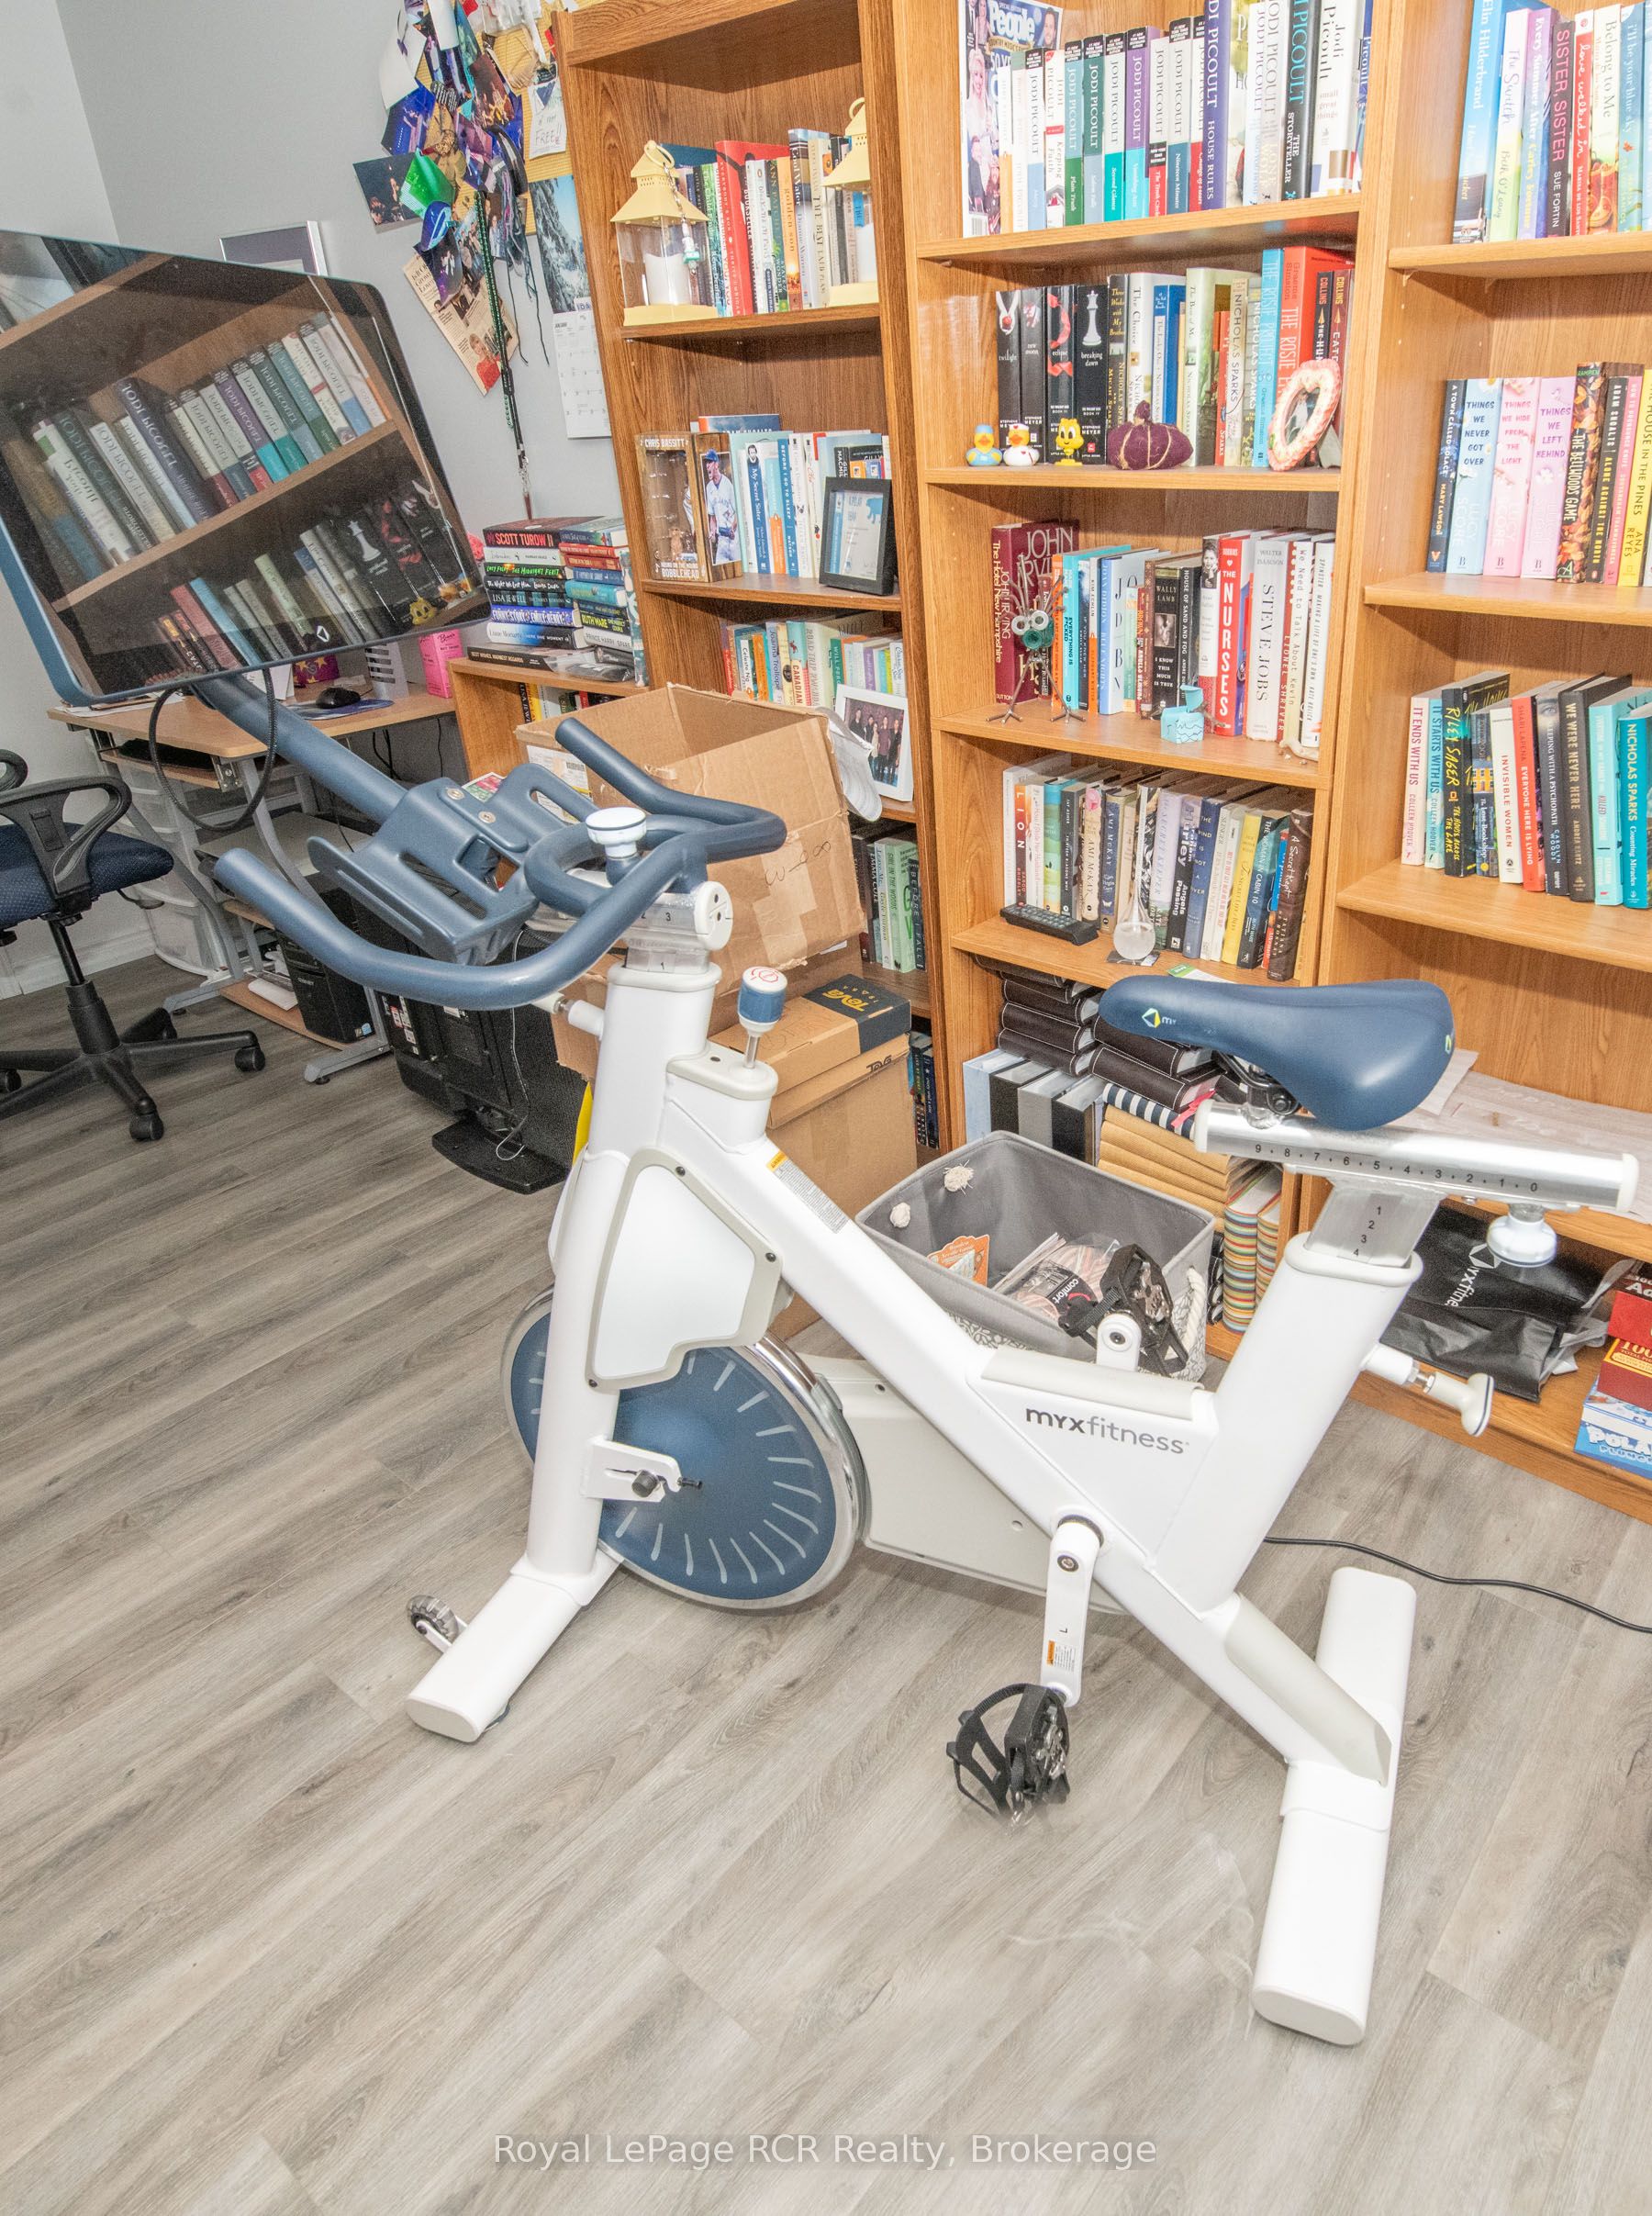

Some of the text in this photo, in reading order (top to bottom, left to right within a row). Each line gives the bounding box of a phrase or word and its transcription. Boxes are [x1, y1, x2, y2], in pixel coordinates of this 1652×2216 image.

[992, 2, 1035, 40] People
[1289, 10, 1309, 104] PICOULT
[1319, 6, 1336, 80] Picoult
[1334, 25, 1345, 57] Jodi
[1207, 27, 1219, 107] PICOULT
[1473, 29, 1490, 109] Hilderbrand
[1068, 68, 1077, 151] JODI PICOULT
[1175, 49, 1183, 136] JODI PICOULT
[1552, 30, 1569, 161] SISTER, SISTER
[1577, 44, 1591, 158] love walked in
[1206, 120, 1215, 200] HOUSE RULES
[1285, 112, 1294, 183] STORYTELLER
[1552, 193, 1560, 227] FORTIN
[1132, 286, 1141, 344] The Choice
[1278, 308, 1299, 368] THE ROSIE
[1446, 417, 1455, 445] CALLED
[1607, 385, 1621, 446] ADAM SHOALTS
[1571, 433, 1585, 449] THE
[1443, 447, 1453, 474] SOLACE
[783, 477, 787, 487] GO
[784, 488, 789, 498] TO
[1436, 484, 1447, 535] MARY LAWSON
[1564, 498, 1578, 521] GAME
[1593, 457, 1612, 564] ALONE AGAINST THE NORTH
[496, 533, 545, 546] SCOTT TUROW
[993, 541, 1001, 558] The
[1300, 550, 1307, 562] We
[1624, 527, 1635, 557] REYES
[1634, 532, 1642, 554] ANA
[1297, 568, 1305, 591] Need
[492, 593, 526, 603] LISA JEWELL
[1183, 595, 1189, 603] OF
[1295, 599, 1303, 609] to
[1256, 585, 1274, 701] STEVE JOBS
[1293, 616, 1302, 637] Talk
[769, 630, 781, 690] Joanna Trollope
[1220, 583, 1233, 716] NURSES
[1291, 644, 1300, 671] About
[744, 673, 751, 681] Ng
[792, 665, 802, 703] CANADIAN
[1278, 685, 1287, 731] SHRIVER
[1409, 708, 1423, 785] IT ENDS WITH US
[1446, 708, 1460, 785] RILEY SAGER
[1566, 703, 1580, 809] WE WERE NEVER HERE
[1522, 767, 1531, 806] EVERYONE
[1628, 724, 1637, 821] NICHOLAS SPARKS
[1501, 755, 1512, 847] INVISIBLE WOMEN
[1017, 792, 1025, 848] LION
[1524, 810, 1532, 830] HERE
[1258, 835, 1269, 864] WOMAN
[1287, 846, 1298, 872] Secret
[910, 872, 919, 916] BEFORE
[1173, 880, 1182, 916] Passing
[1179, 885, 1188, 914] Angels
[1252, 896, 1259, 904] 10
[1254, 874, 1263, 893] CABIN
[1282, 874, 1293, 898] Kept
[665, 912, 671, 921] 3
[1255, 1144, 1537, 1192] 9 8 7 6 5 4 3 2 1 0
[1368, 1220, 1374, 1229] 2
[1378, 1206, 1381, 1215] 1
[1361, 1235, 1367, 1243] 3
[1053, 1279, 1078, 1304] comfort
[1026, 1408, 1184, 1454] myxfitness
